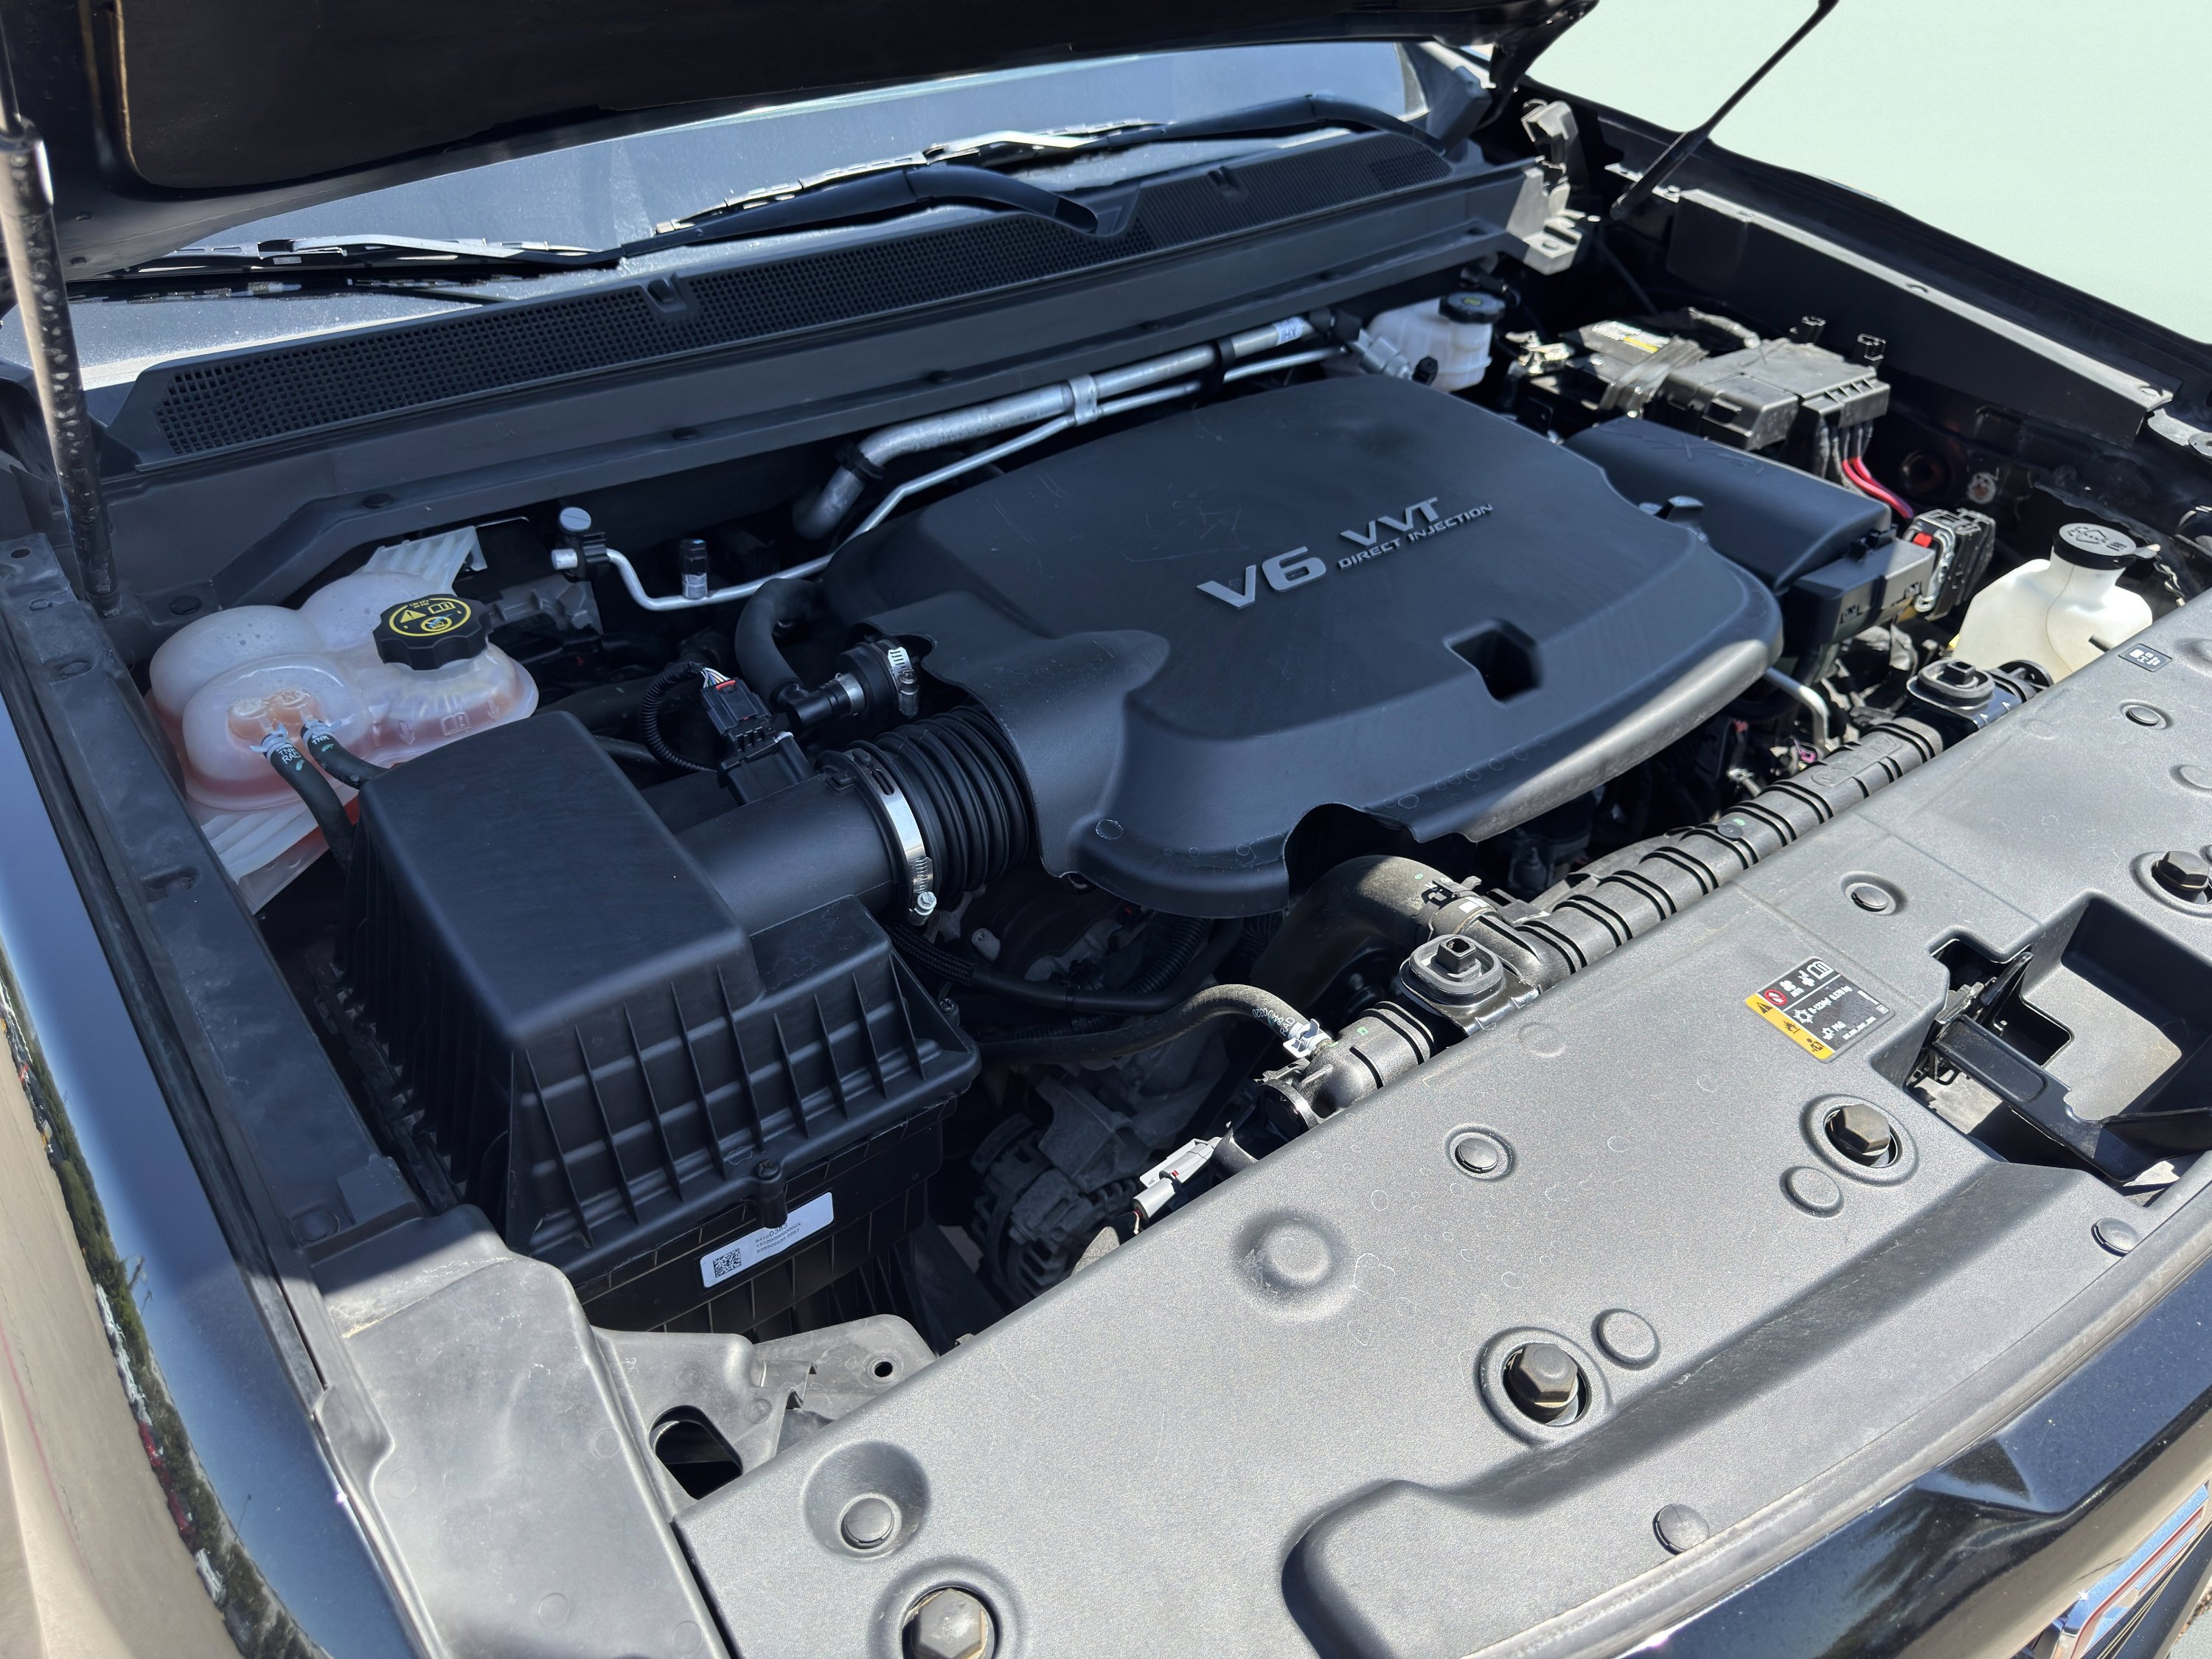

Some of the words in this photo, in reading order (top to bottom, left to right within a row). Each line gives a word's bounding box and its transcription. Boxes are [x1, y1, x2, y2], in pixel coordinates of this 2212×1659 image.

[1337, 537, 1403, 570] DIRECT
[1408, 503, 1493, 543] INJECTION
[1339, 496, 1439, 548] VVT
[1196, 546, 1327, 610] V6
[282, 751, 302, 765] RAD
[312, 735, 330, 745] TNK
[1279, 1017, 1295, 1037] RAD
